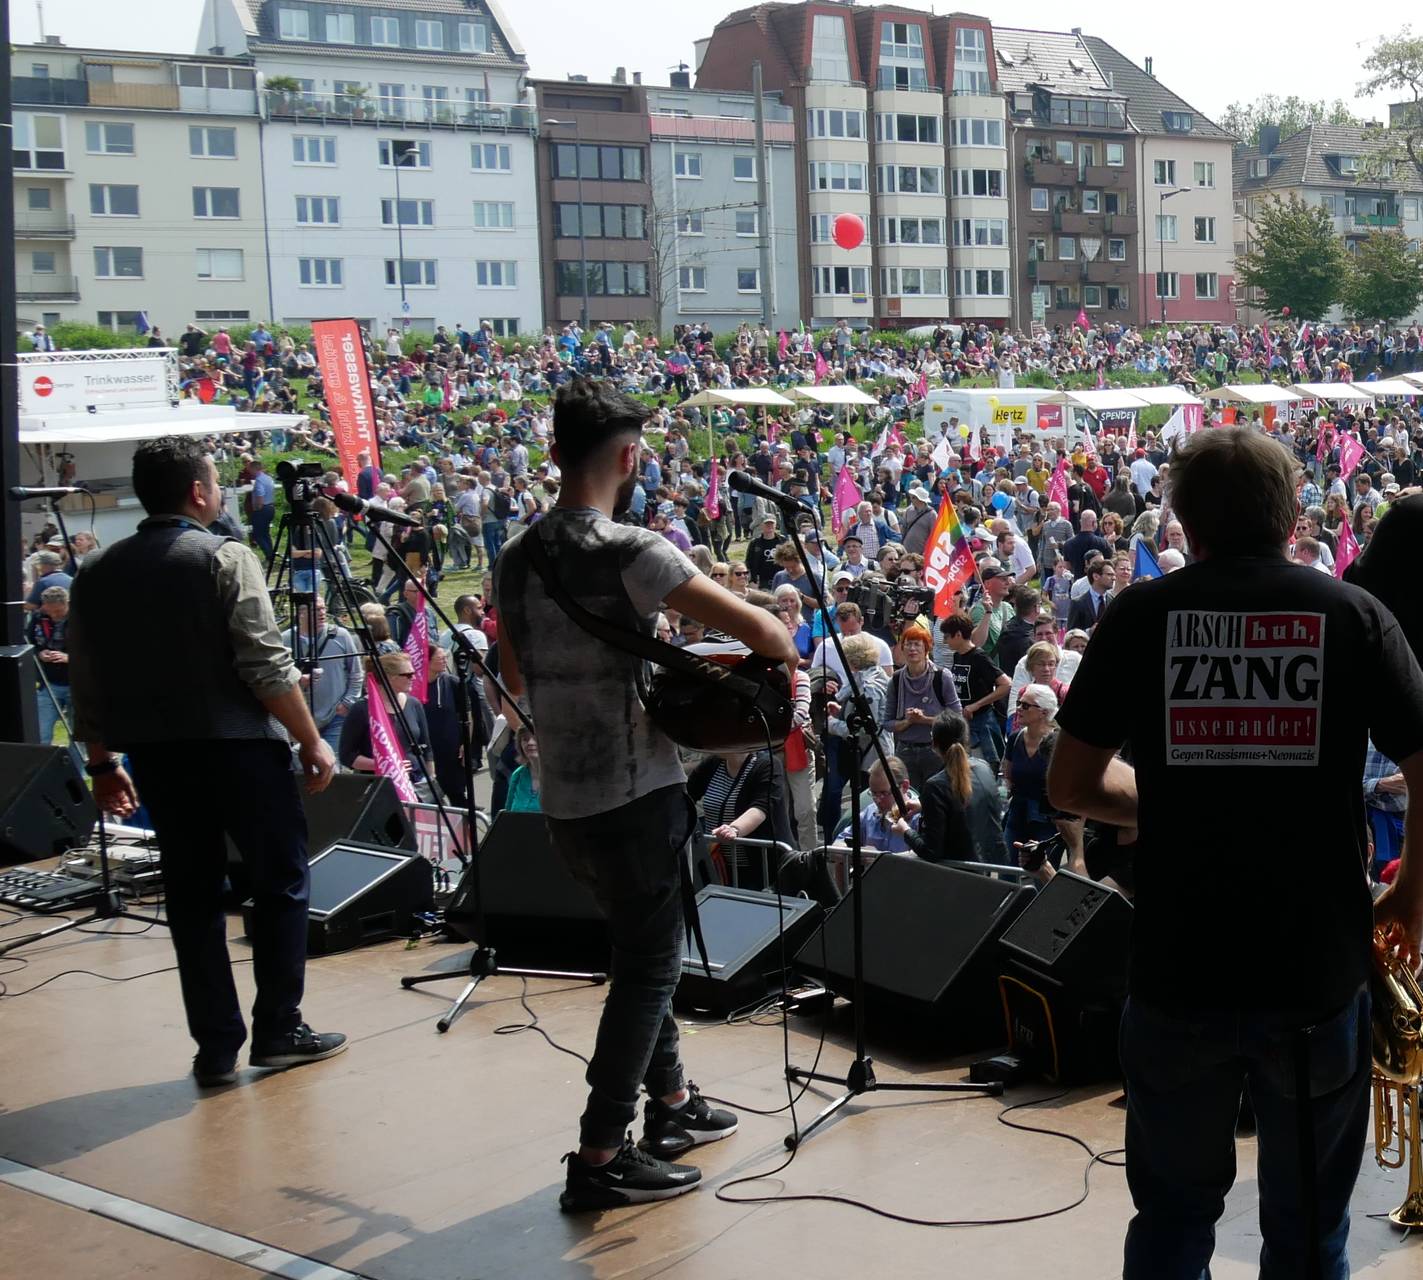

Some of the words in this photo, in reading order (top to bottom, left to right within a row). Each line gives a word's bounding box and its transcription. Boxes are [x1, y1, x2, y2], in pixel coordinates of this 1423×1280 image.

[995, 408, 1023, 423] Hertz
[1170, 613, 1243, 649] ARSCH
[1251, 620, 1314, 643] huh,
[1169, 654, 1320, 702] ZÄNG
[1175, 714, 1312, 737] ussenander!
[1171, 749, 1204, 763] Gegen
